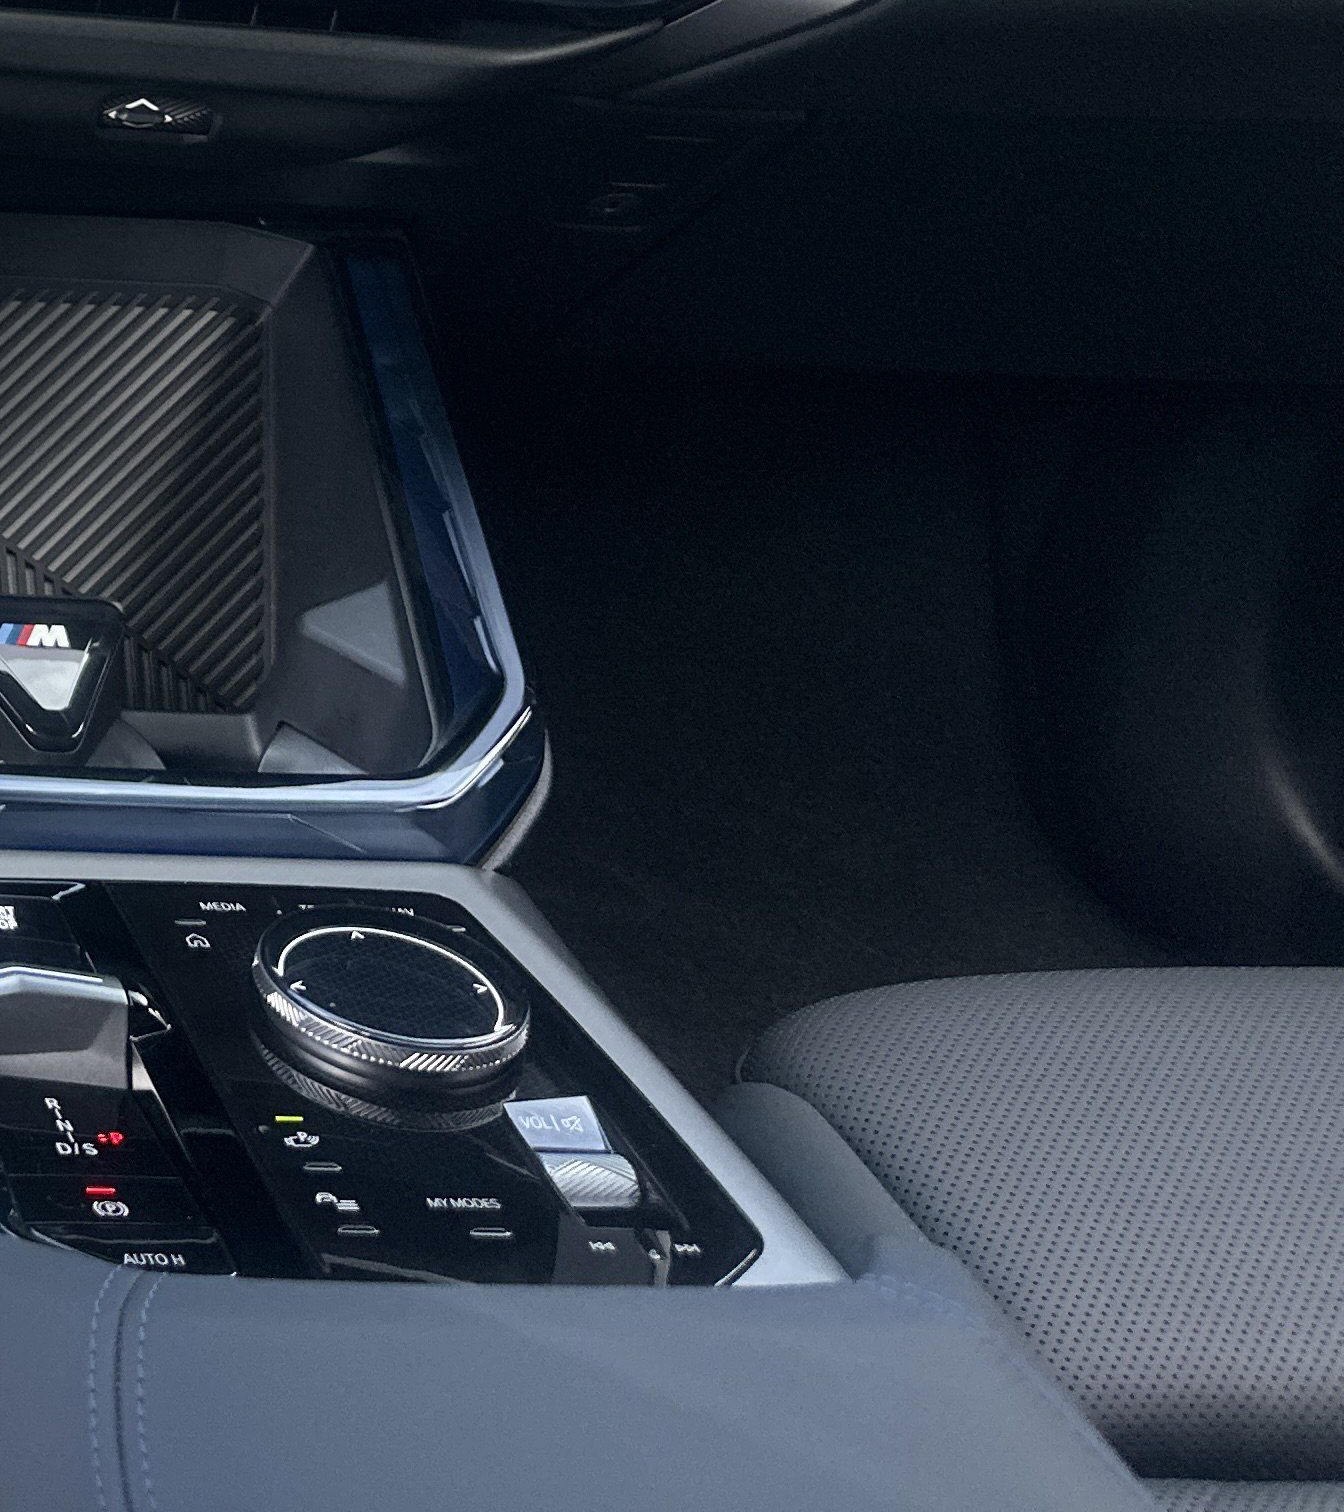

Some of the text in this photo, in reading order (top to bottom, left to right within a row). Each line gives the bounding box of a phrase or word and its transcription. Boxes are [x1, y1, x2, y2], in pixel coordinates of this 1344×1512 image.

[25, 623, 70, 648] M
[199, 901, 246, 913] MEDIA
[521, 1115, 552, 1128] VOL
[426, 1197, 502, 1209] MY MODES
[123, 1253, 187, 1266] AUTO H
